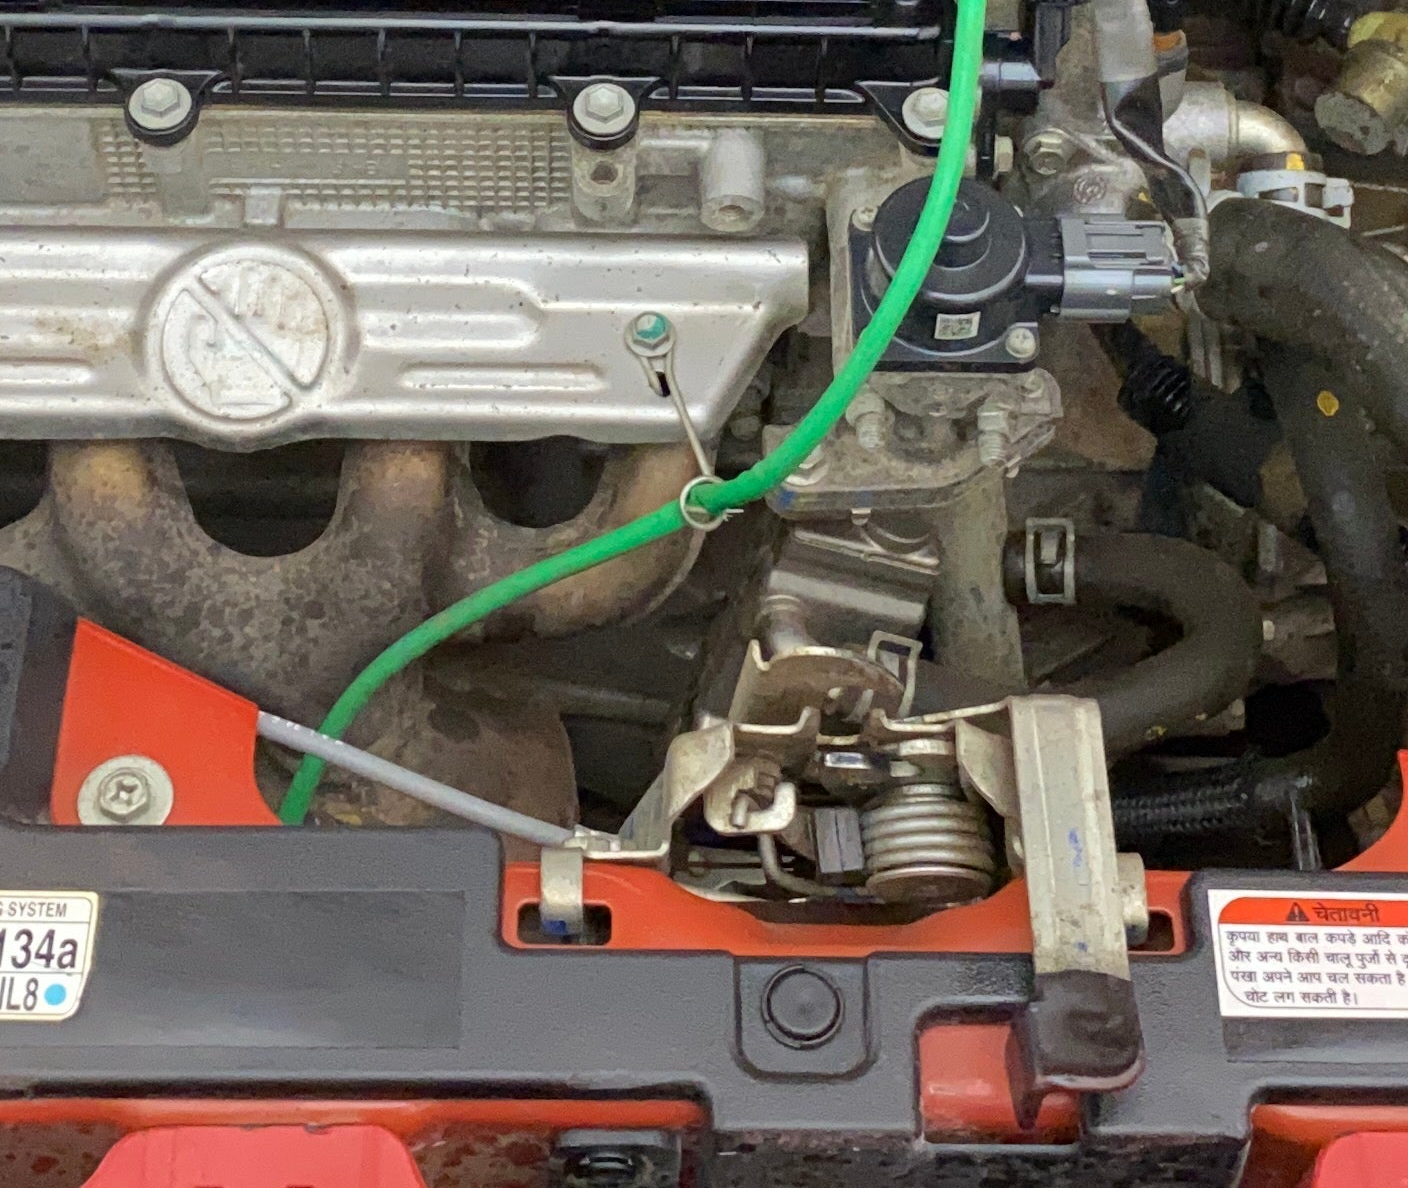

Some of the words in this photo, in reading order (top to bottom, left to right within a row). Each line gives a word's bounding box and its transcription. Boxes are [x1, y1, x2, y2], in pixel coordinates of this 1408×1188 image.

[7, 902, 67, 917] SYSTEM
[1312, 903, 1379, 923] चेतावनी
[1226, 930, 1260, 948] कृपया
[1266, 931, 1289, 944] हाथ
[1295, 931, 1319, 945] बाल
[1362, 929, 1390, 946] आदि
[1228, 947, 1251, 962] और
[1256, 950, 1283, 963] अन्य
[1288, 947, 1320, 964] किसी
[1324, 951, 1352, 968] चालू
[1384, 950, 1397, 965] से
[1230, 966, 1257, 982] पंखा
[1263, 968, 1292, 983] अपने
[1297, 971, 1322, 983] आप
[1326, 972, 1349, 984] चल
[1354, 972, 1392, 985] सकता
[1396, 970, 1406, 986] है
[1244, 988, 1268, 1003] चोट
[1273, 990, 1295, 1003] लग
[1299, 988, 1337, 1004] सकती
